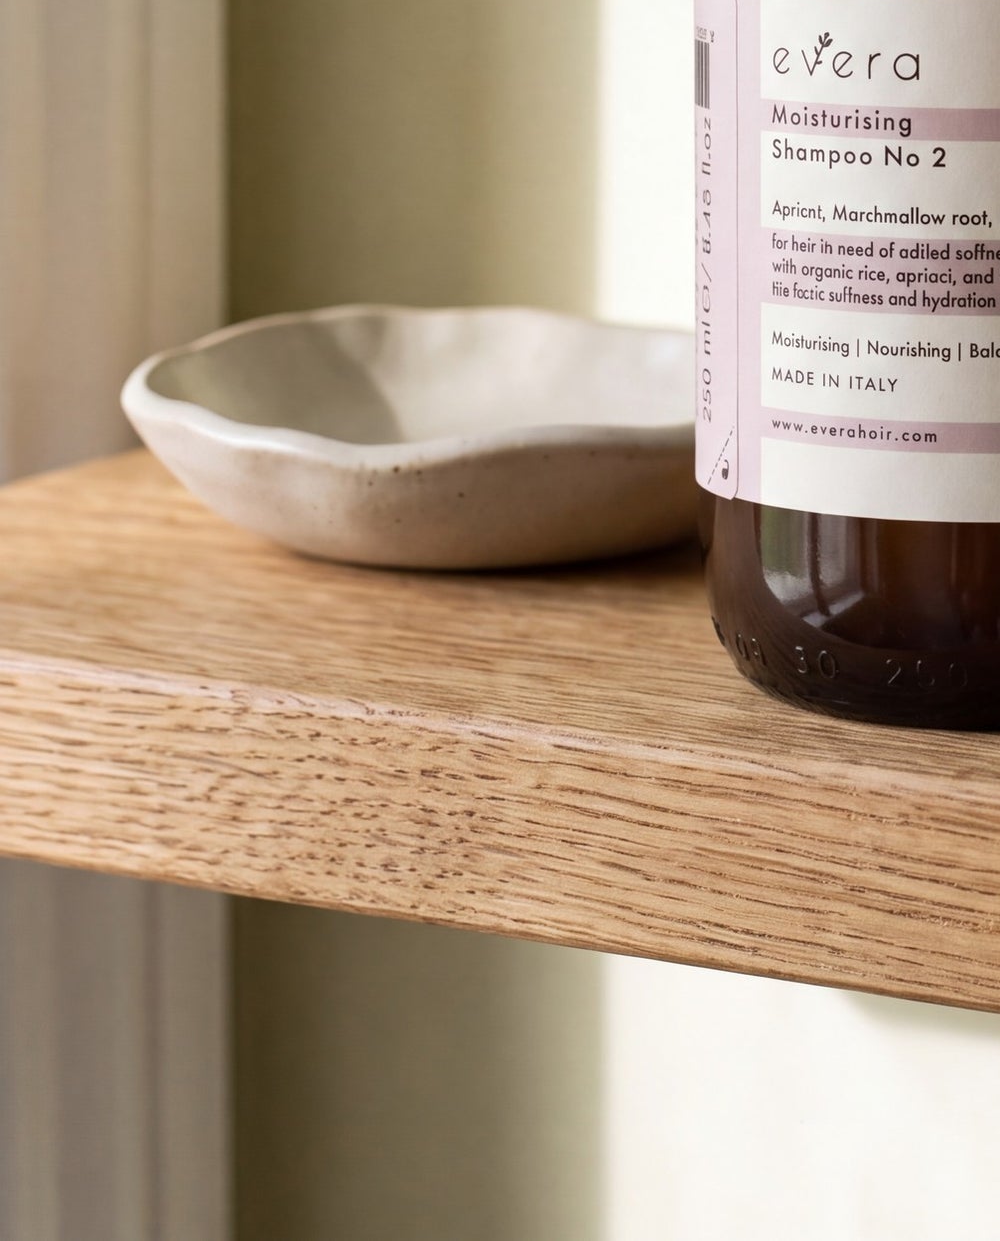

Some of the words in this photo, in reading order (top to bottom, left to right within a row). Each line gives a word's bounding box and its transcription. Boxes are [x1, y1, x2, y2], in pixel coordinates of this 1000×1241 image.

[772, 31, 920, 81] evera
[771, 104, 912, 138] Moisturising
[772, 137, 873, 170] Shampoo
[884, 145, 920, 168] No
[932, 146, 946, 168] 2
[952, 210, 993, 229] root,
[771, 232, 789, 251] for
[837, 241, 874, 258] need
[878, 241, 896, 259] of
[771, 257, 797, 275] with
[801, 263, 854, 283] organic
[858, 264, 890, 285] rice,
[962, 267, 994, 285] and
[888, 289, 916, 307] and
[922, 289, 996, 313] hydration
[701, 321, 711, 355] ml
[771, 330, 850, 358] Moisturising
[867, 339, 951, 363] Nourishing
[703, 368, 712, 423] 250
[771, 367, 815, 386] MADE
[822, 373, 840, 388] IN
[849, 375, 898, 393] ITALY
